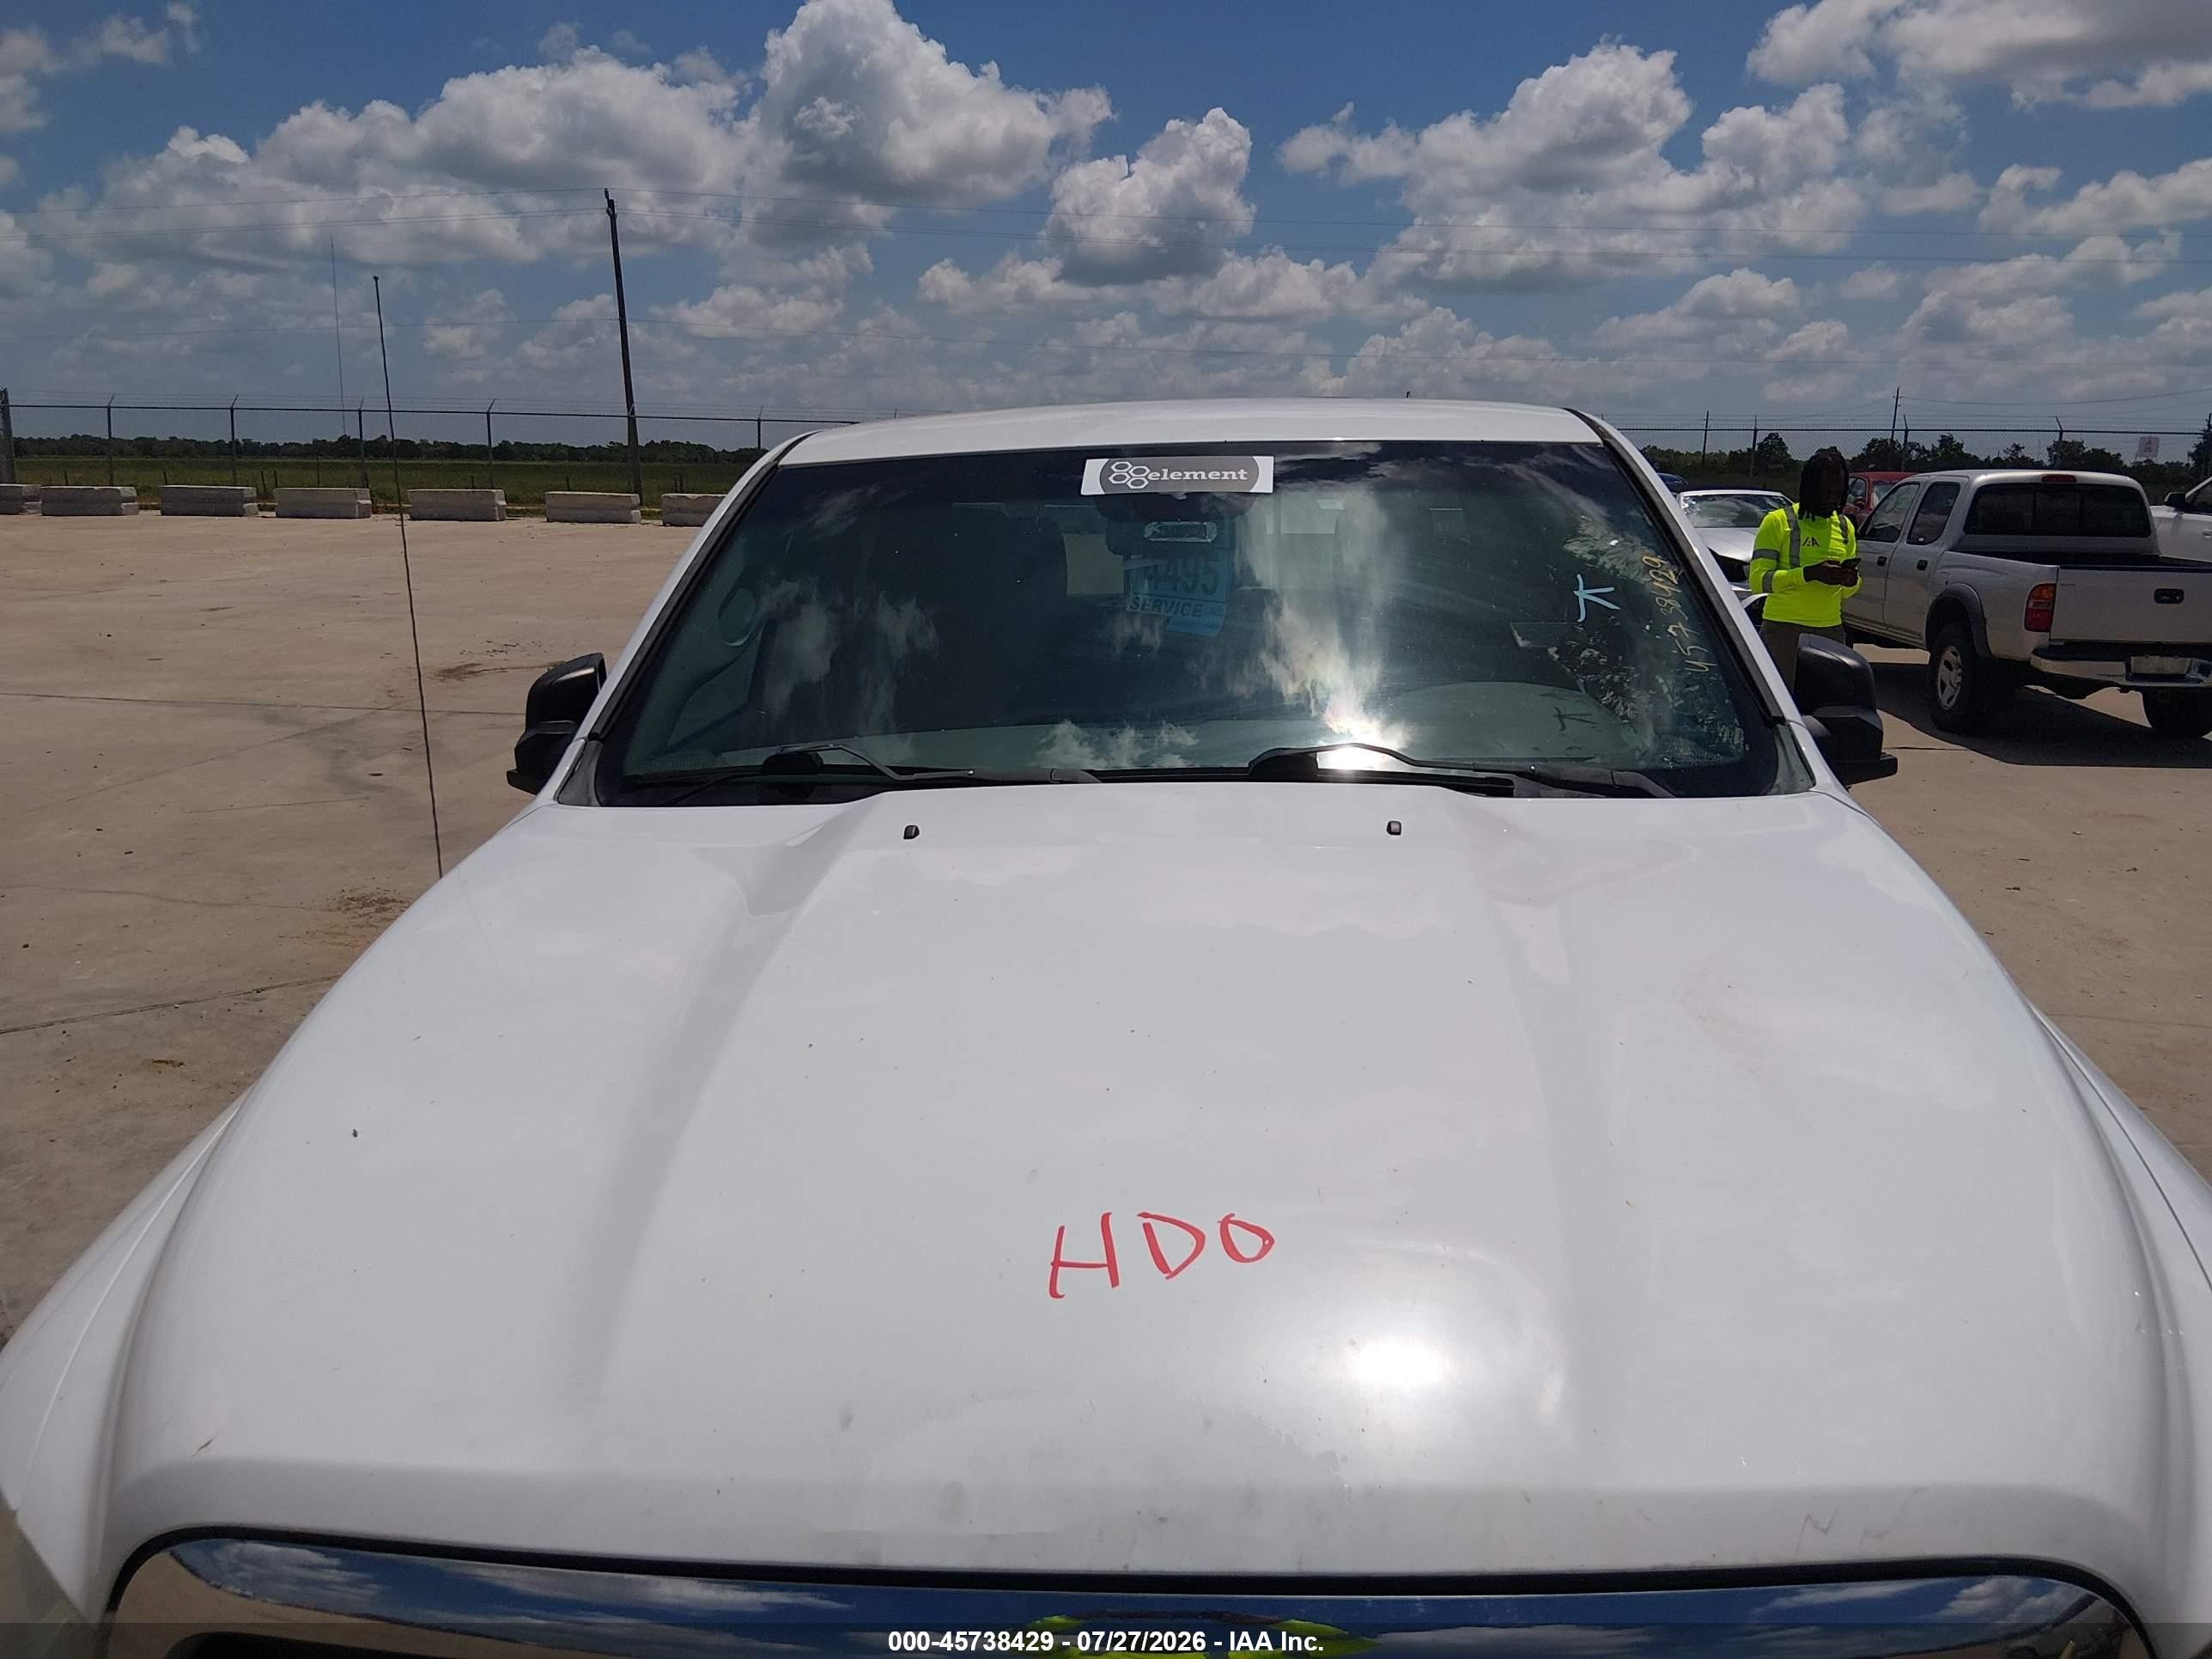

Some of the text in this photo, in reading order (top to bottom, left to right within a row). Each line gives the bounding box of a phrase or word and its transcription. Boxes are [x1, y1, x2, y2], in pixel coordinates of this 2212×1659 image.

[1148, 468, 1248, 481] element
[1129, 596, 1204, 617] SERVICE
[1573, 573, 1621, 623] K
[1048, 1212, 1275, 1299] HDO
